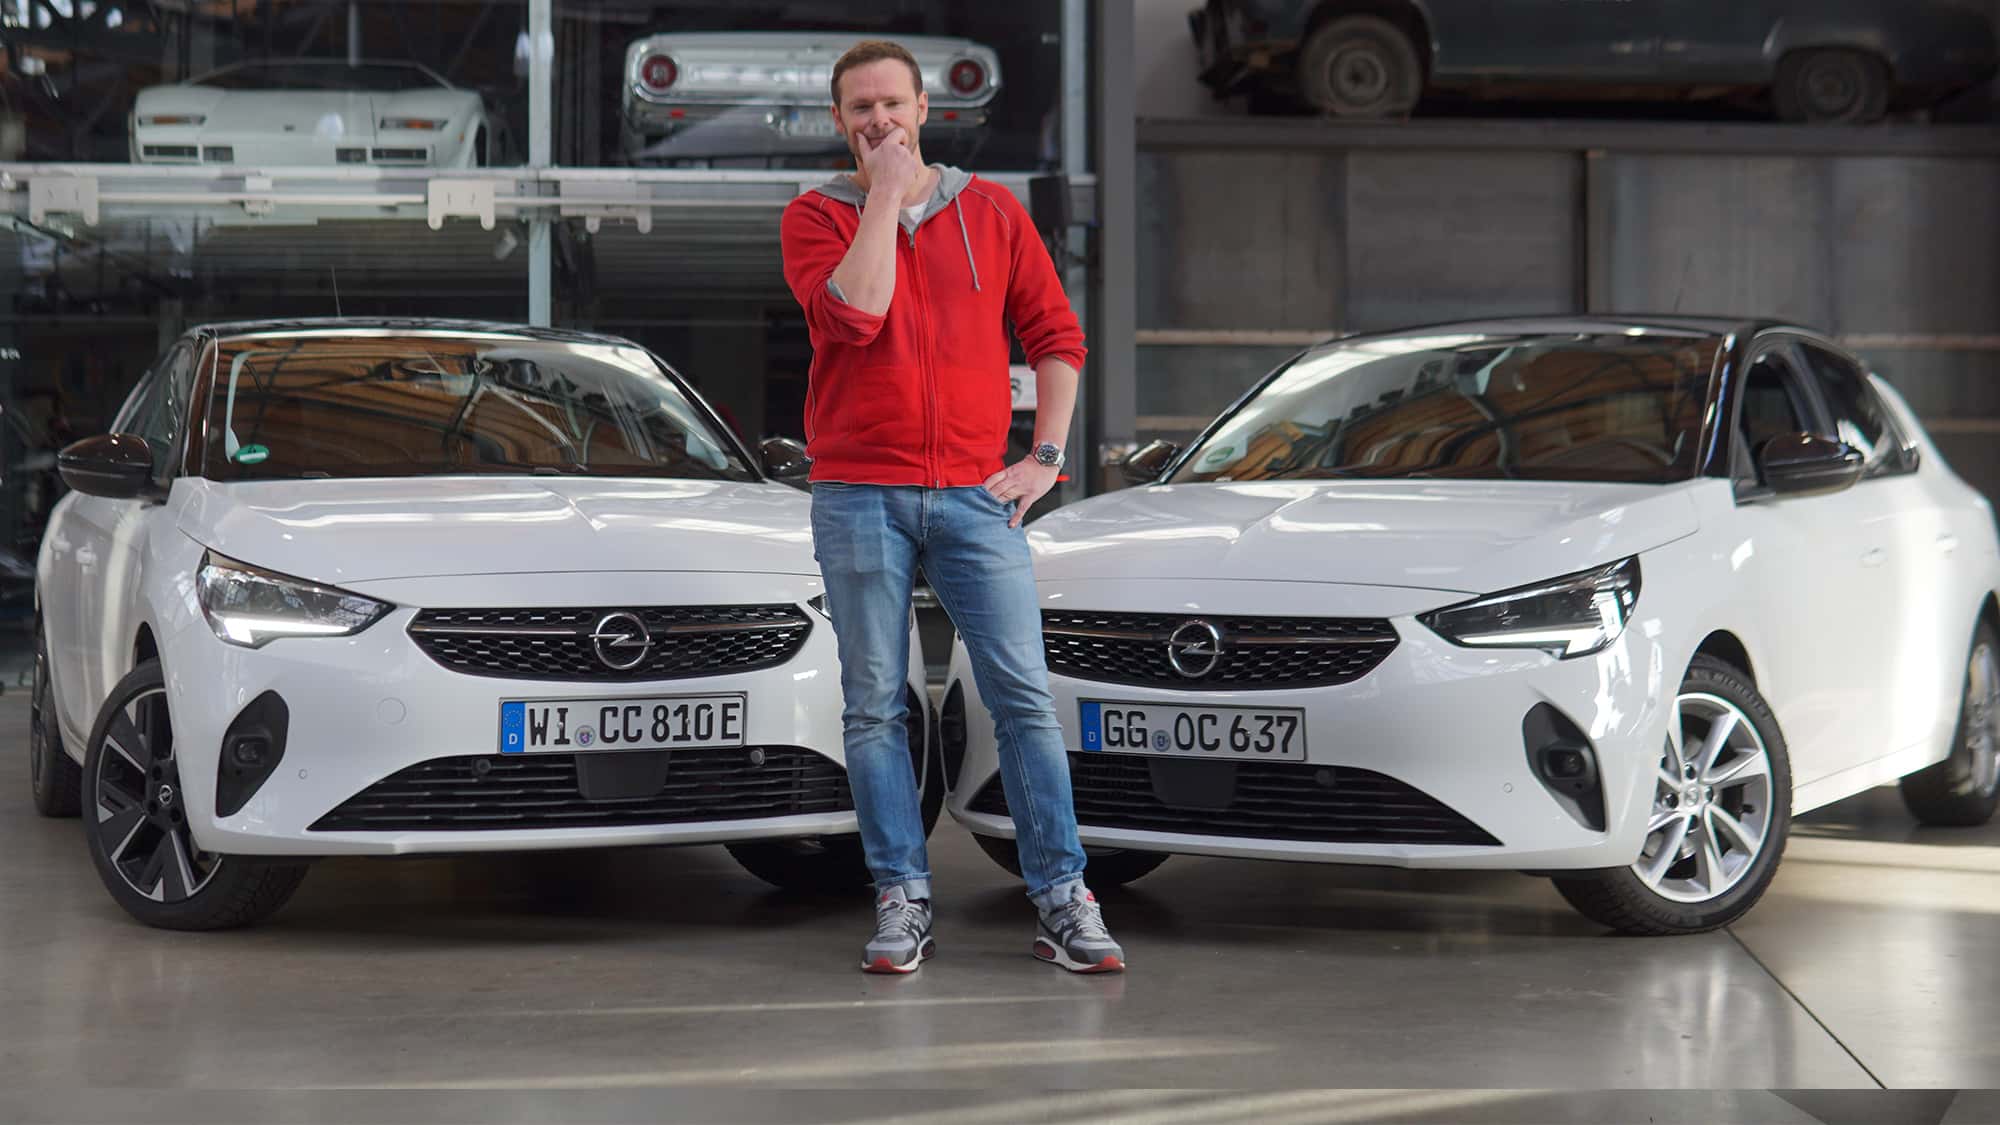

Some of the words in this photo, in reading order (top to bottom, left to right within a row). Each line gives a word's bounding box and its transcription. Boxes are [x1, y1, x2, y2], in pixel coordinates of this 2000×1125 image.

[508, 733, 518, 745] D
[528, 707, 571, 746] WI
[599, 705, 643, 744] CC
[1104, 710, 1148, 749] GG
[1174, 712, 1221, 752] OC
[1230, 715, 1298, 753] 637
